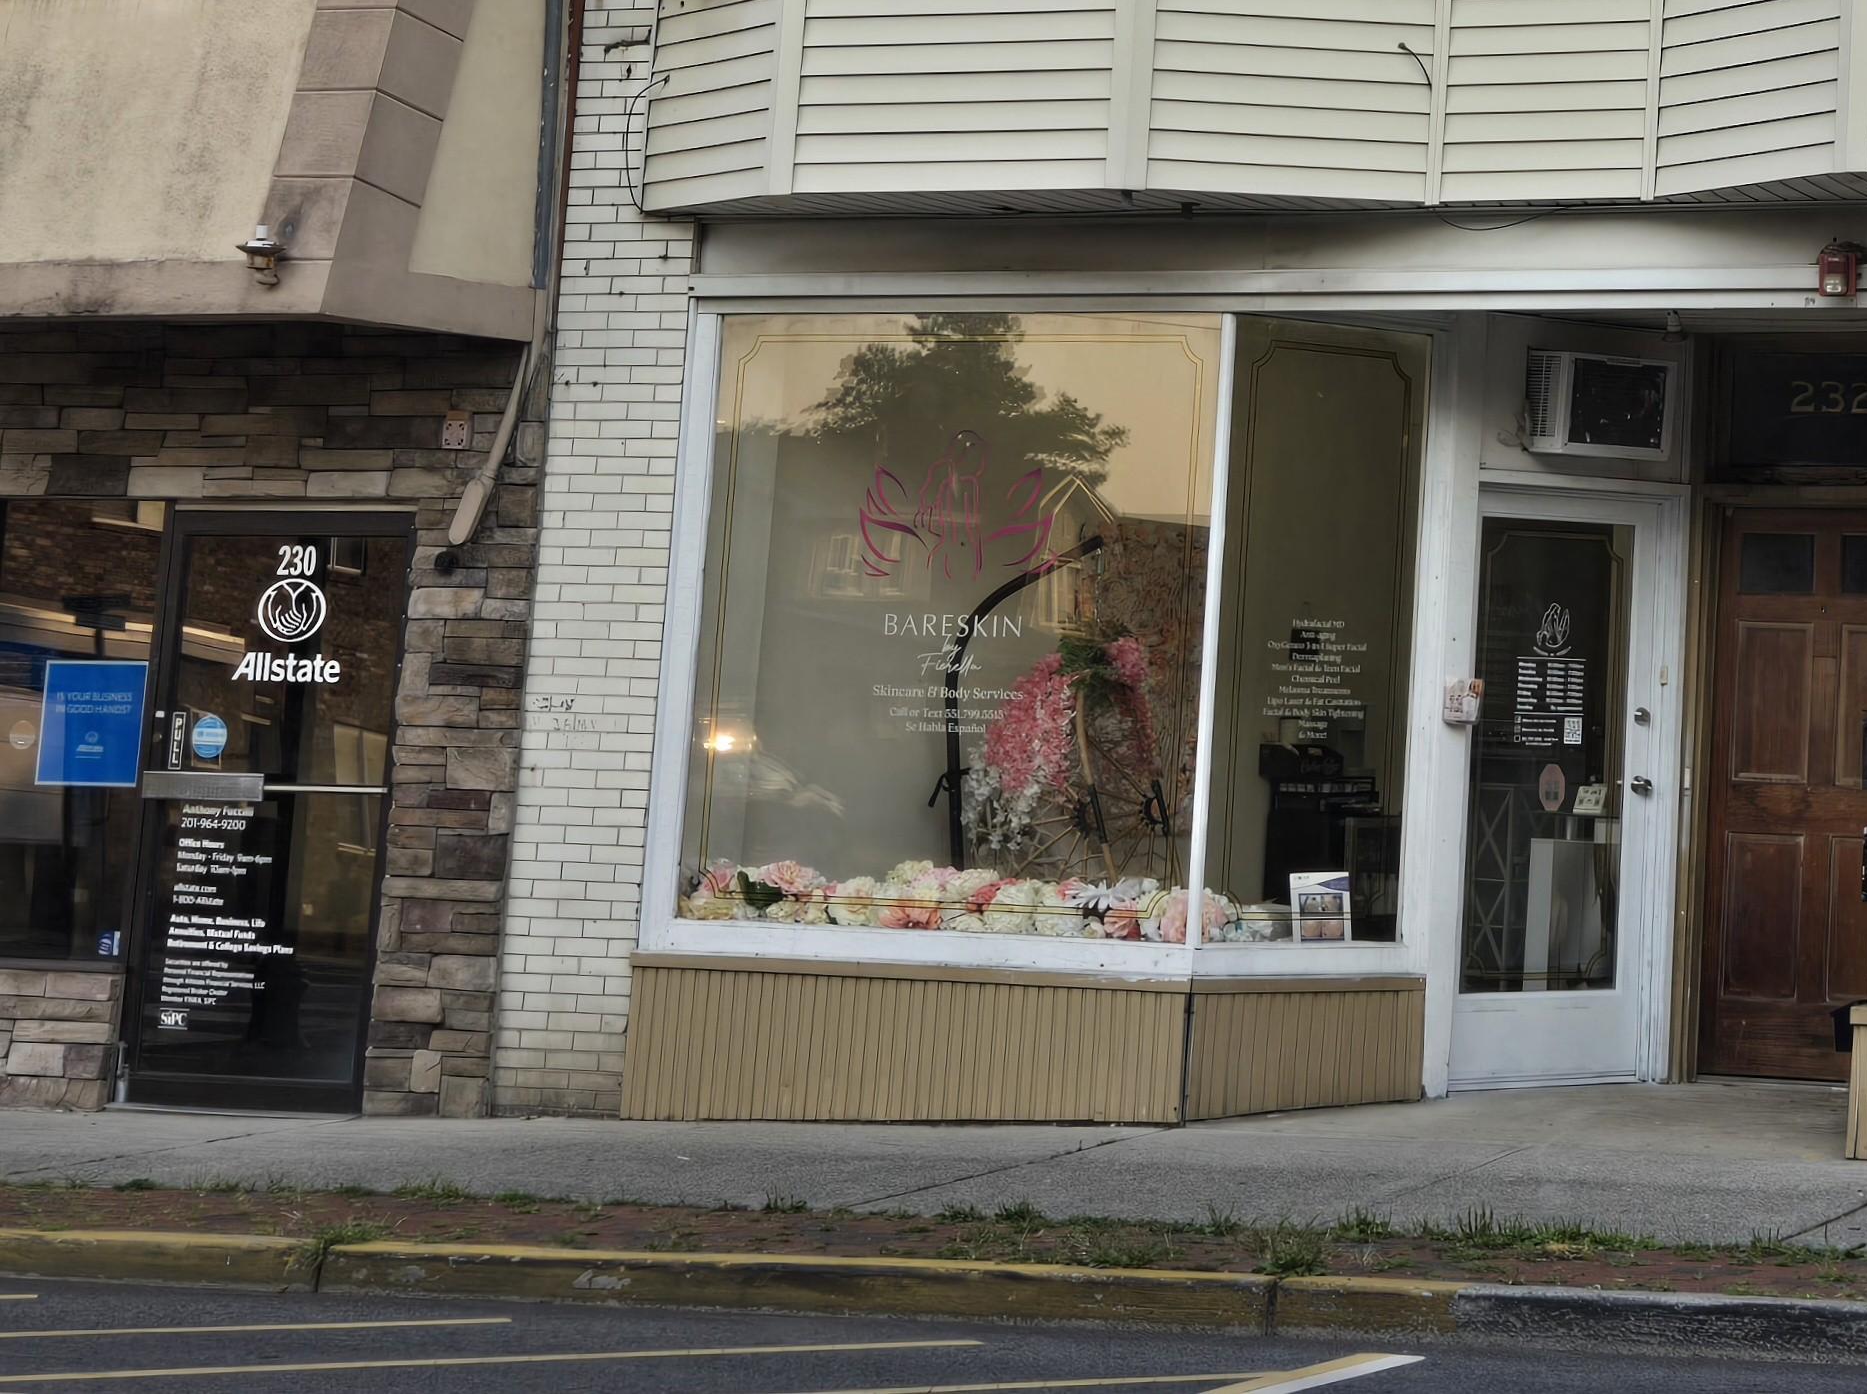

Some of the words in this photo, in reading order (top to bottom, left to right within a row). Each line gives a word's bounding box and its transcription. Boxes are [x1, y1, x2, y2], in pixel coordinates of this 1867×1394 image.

[276, 545, 317, 576] 230
[884, 613, 1022, 638] BARESKIN
[941, 634, 962, 663] by
[231, 652, 341, 683] Allstate
[872, 685, 925, 698] Skincare
[927, 686, 938, 698] &
[940, 686, 970, 702] Body
[972, 687, 1025, 700] Services
[889, 707, 908, 718] Call
[922, 708, 942, 719] Text
[171, 717, 183, 764] PULL
[919, 721, 946, 733] Habla
[948, 722, 986, 736] Español
[181, 817, 246, 831] 201-964-9200
